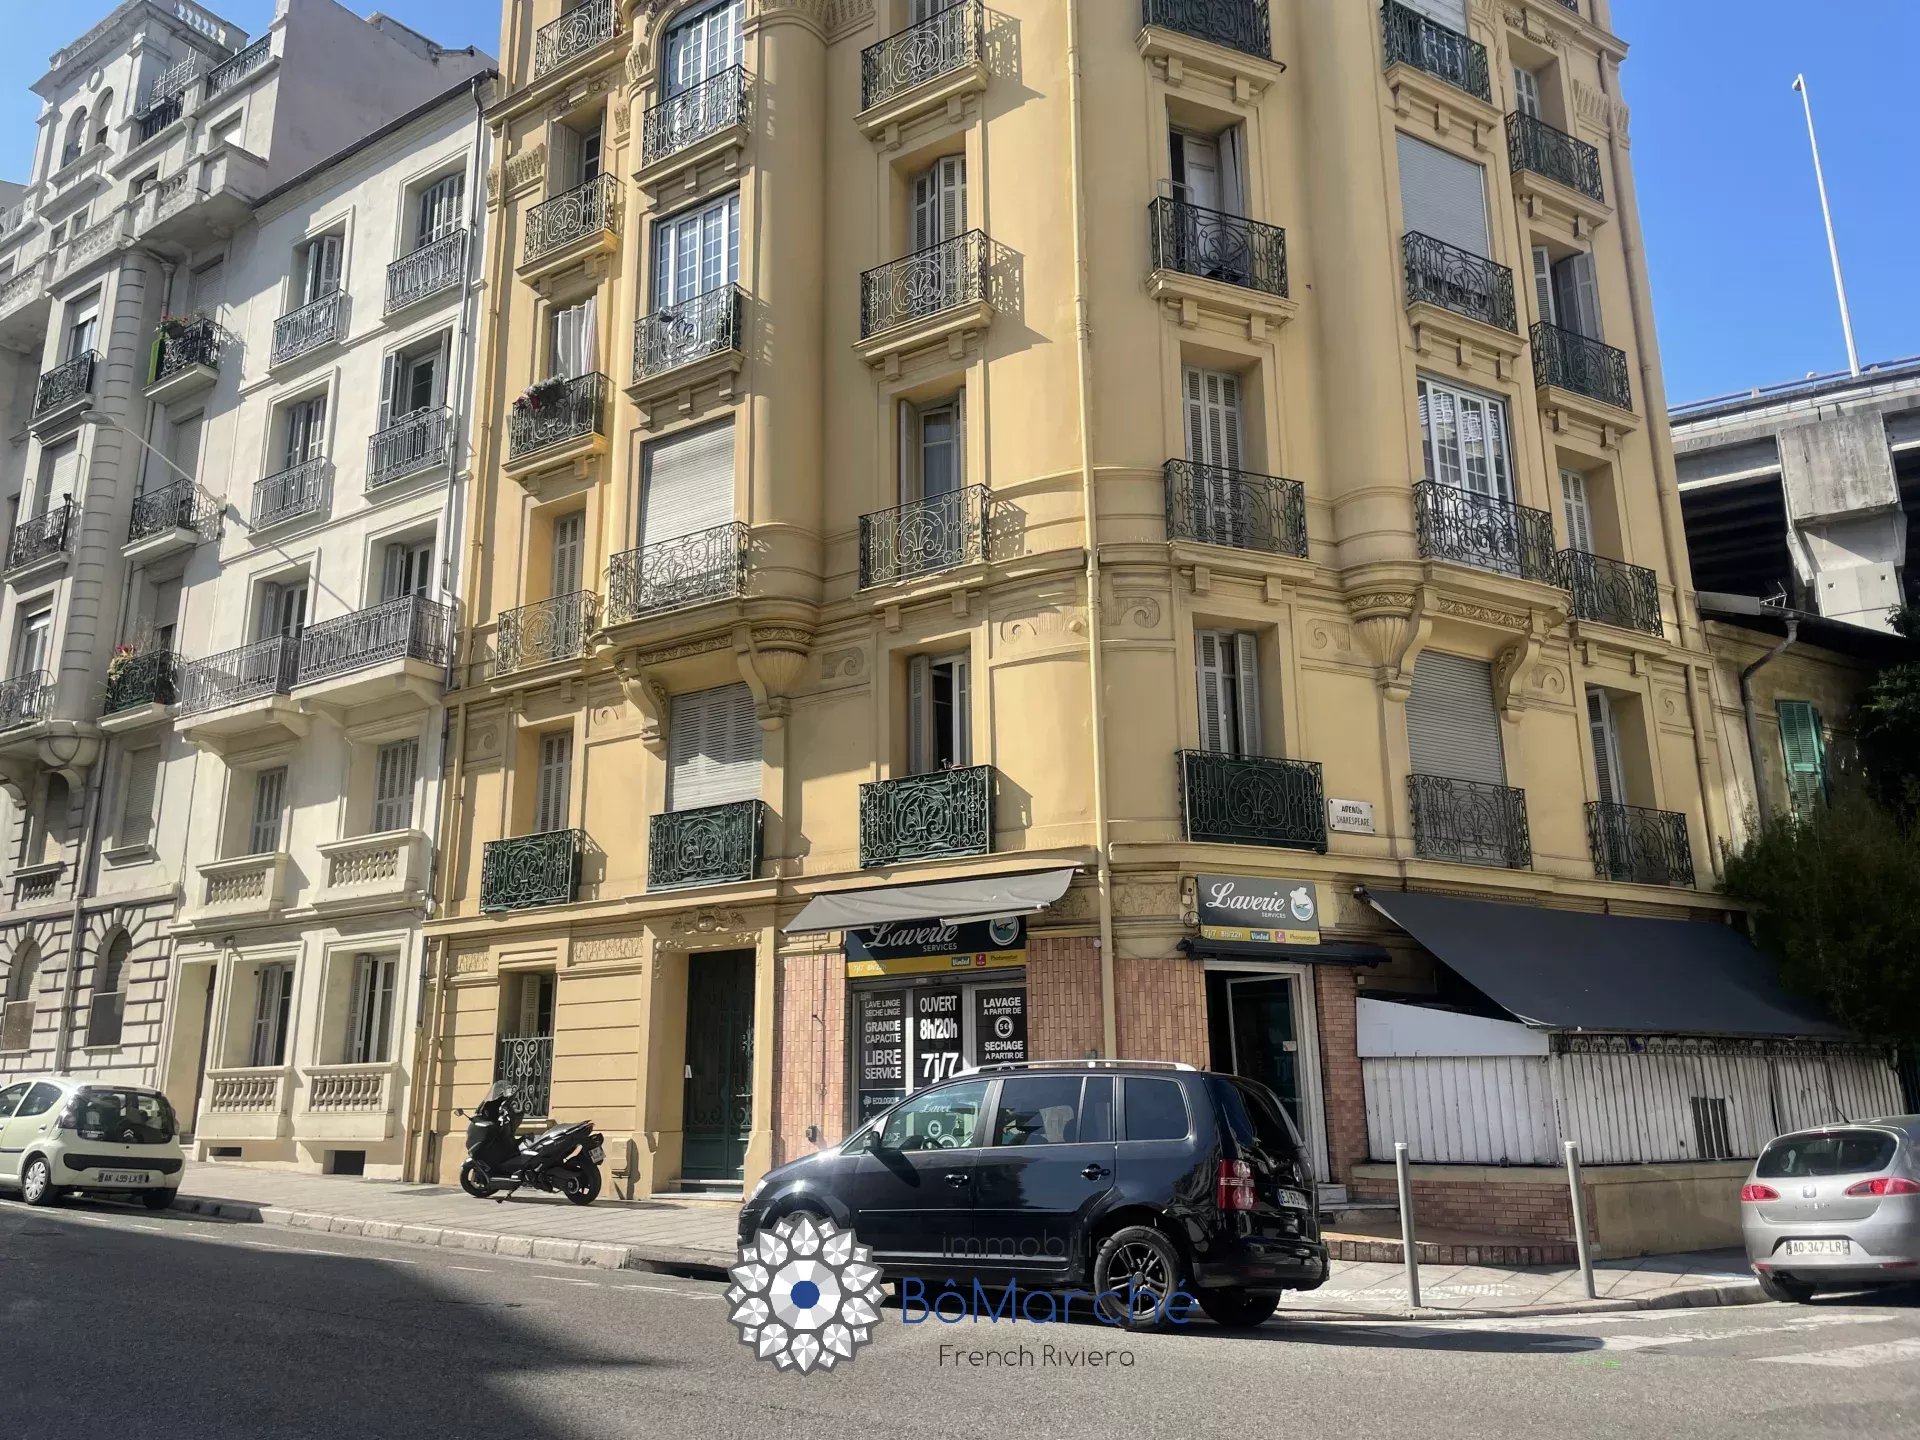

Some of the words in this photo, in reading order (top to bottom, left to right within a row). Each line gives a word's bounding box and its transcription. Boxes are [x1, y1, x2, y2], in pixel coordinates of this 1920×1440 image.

[1336, 815, 1370, 827] SHAKESPEARE
[1206, 882, 1286, 912] Laverie
[1261, 911, 1287, 919] SERVICES
[862, 921, 959, 949] Laverie
[922, 942, 958, 953] SERVICES
[865, 1000, 882, 1009] LAVE
[882, 998, 901, 1007] LINGE
[920, 995, 958, 1013] OUVERT
[983, 996, 1022, 1008] LAVAGE
[865, 1008, 884, 1017] SECHE
[884, 1007, 901, 1016] LINGE
[989, 1007, 1012, 1016] PARTIR
[1012, 1006, 1022, 1015] DE
[865, 1019, 901, 1033] GRANDE
[920, 1017, 958, 1040] 8h/20h
[865, 1032, 901, 1044] CAPACITE
[984, 1040, 1024, 1052] SECHAGE
[865, 1048, 902, 1066] LIBRE
[991, 1051, 1014, 1060] PARTIR
[1014, 1051, 1025, 1059] DE
[865, 1066, 902, 1080] SERVICE
[921, 1052, 960, 1084] 7j/7
